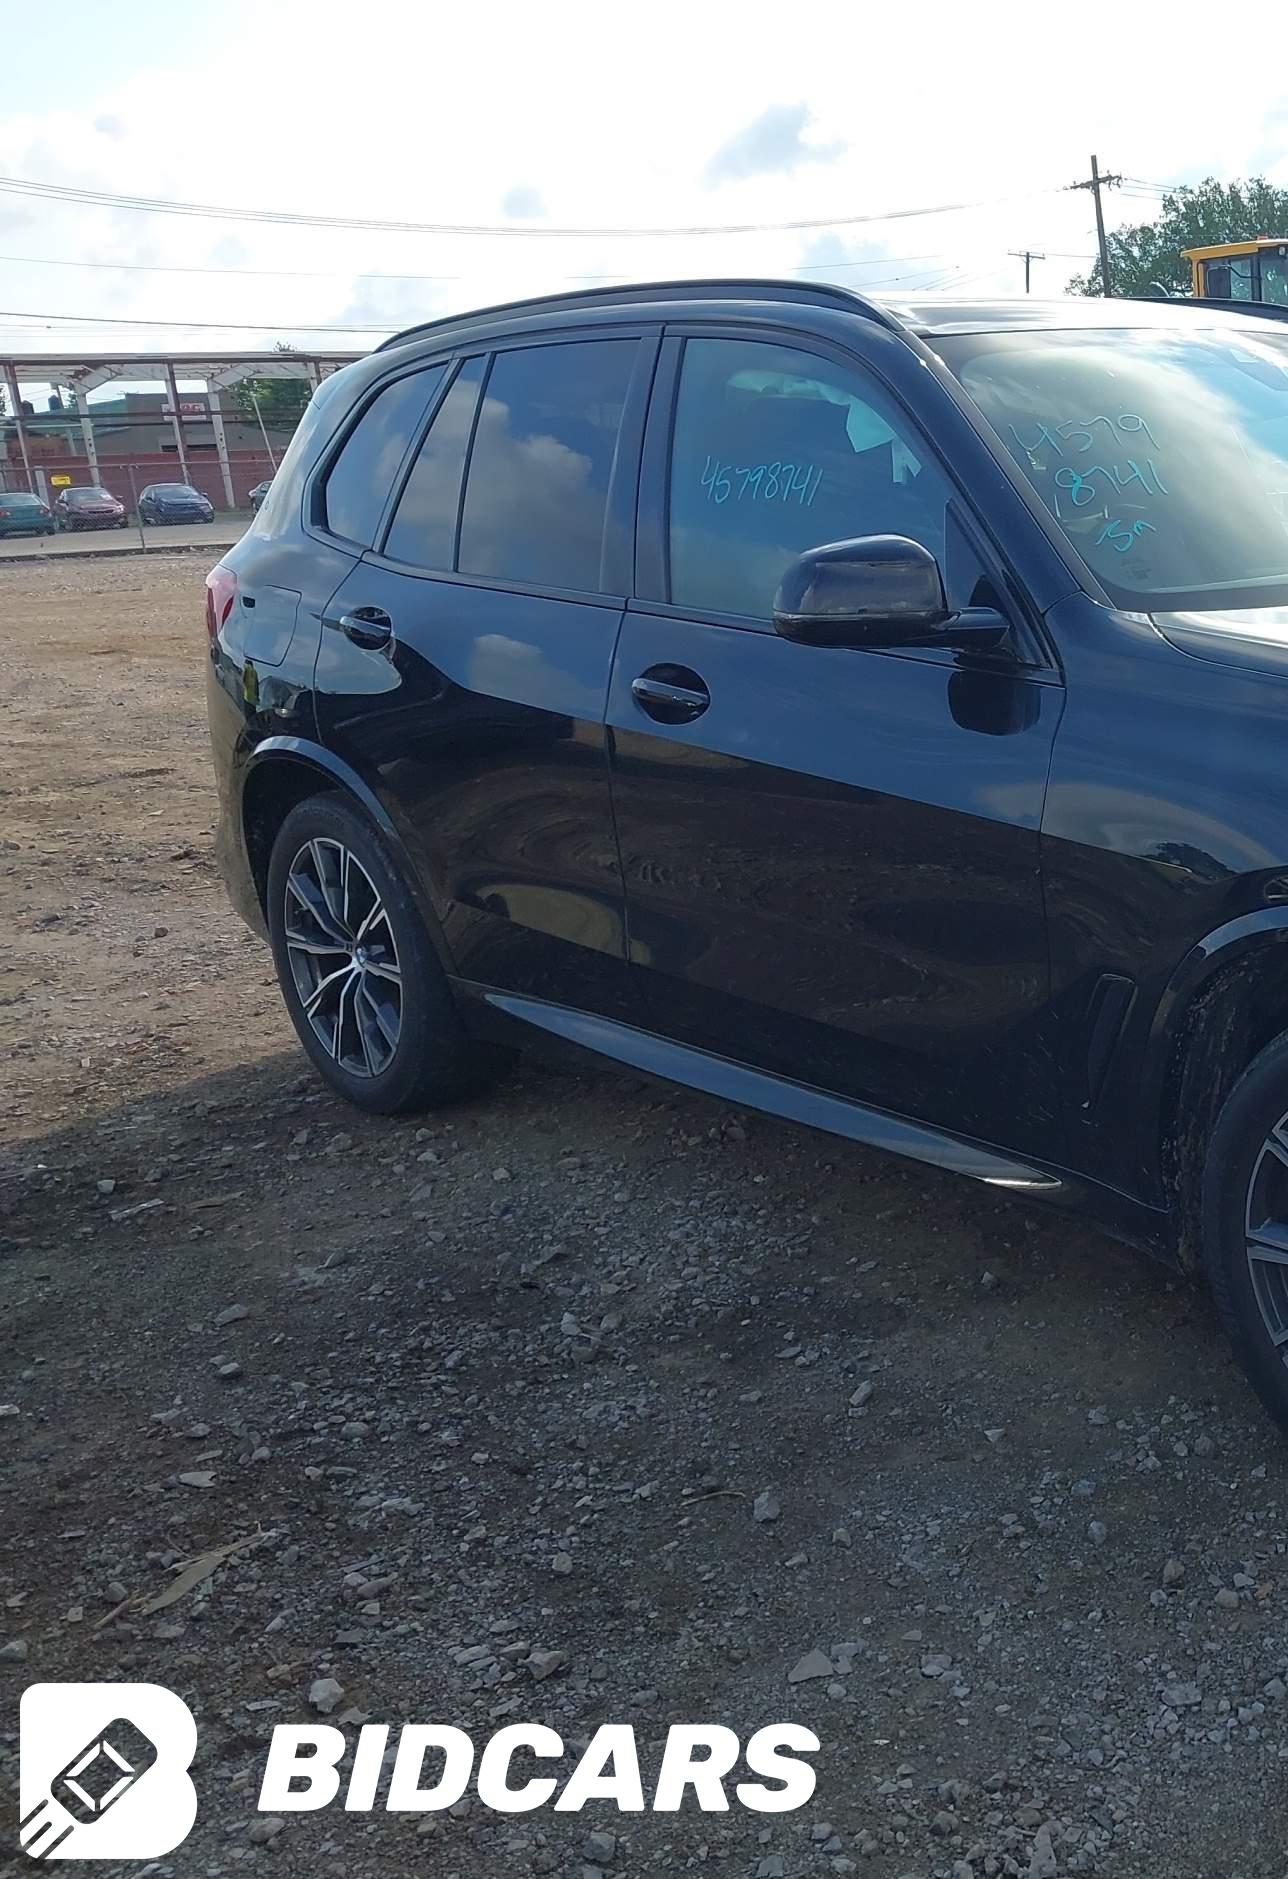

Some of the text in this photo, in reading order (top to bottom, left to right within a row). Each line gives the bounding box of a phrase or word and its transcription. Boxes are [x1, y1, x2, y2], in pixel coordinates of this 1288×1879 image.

[1008, 413, 1161, 457] 4579
[701, 455, 824, 506] 45798741
[1054, 459, 1169, 506] 8741
